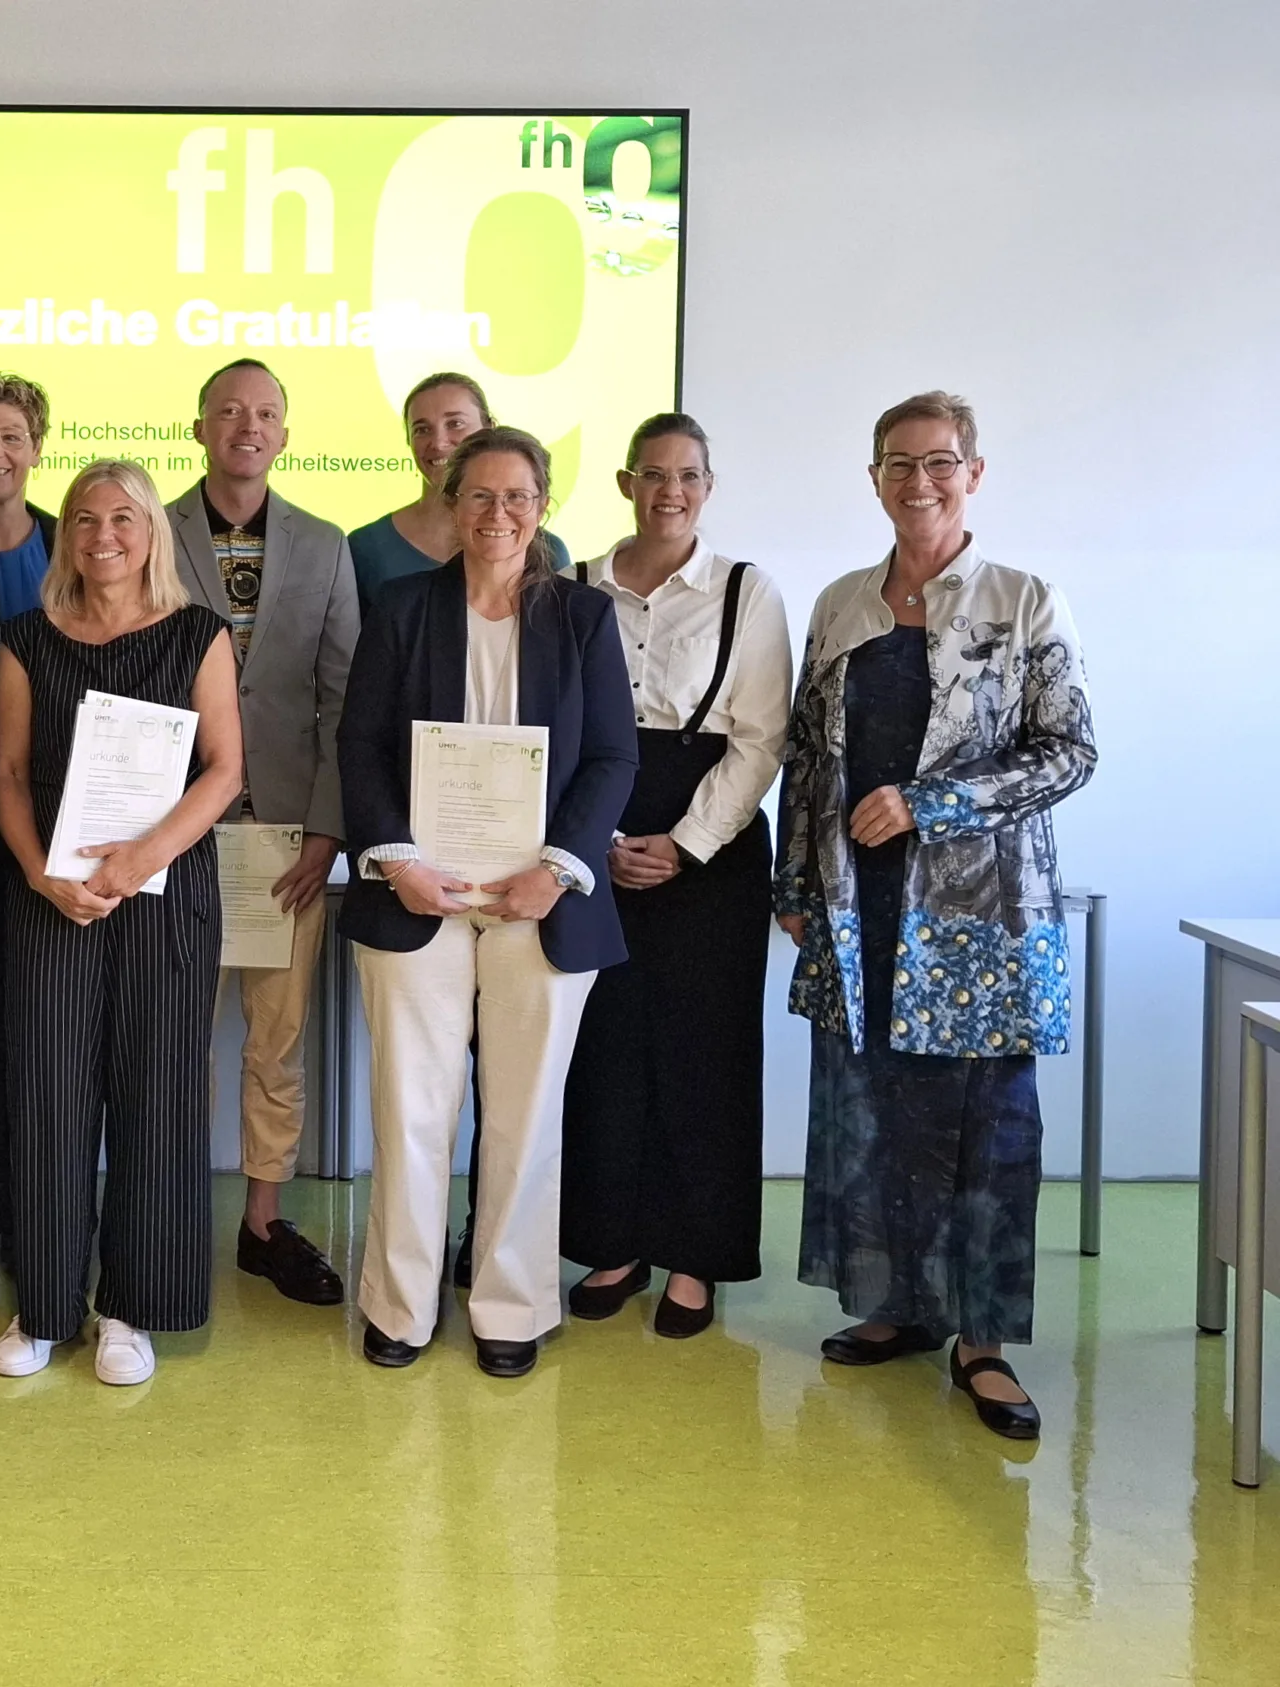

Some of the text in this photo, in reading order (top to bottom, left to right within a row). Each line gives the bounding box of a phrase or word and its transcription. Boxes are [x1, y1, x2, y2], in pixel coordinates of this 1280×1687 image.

[175, 298, 492, 347] Gratulan
[61, 421, 195, 440] Hochschulle
[167, 452, 192, 470] im
[89, 750, 130, 764] urkunde
[438, 778, 483, 791] urkunde
